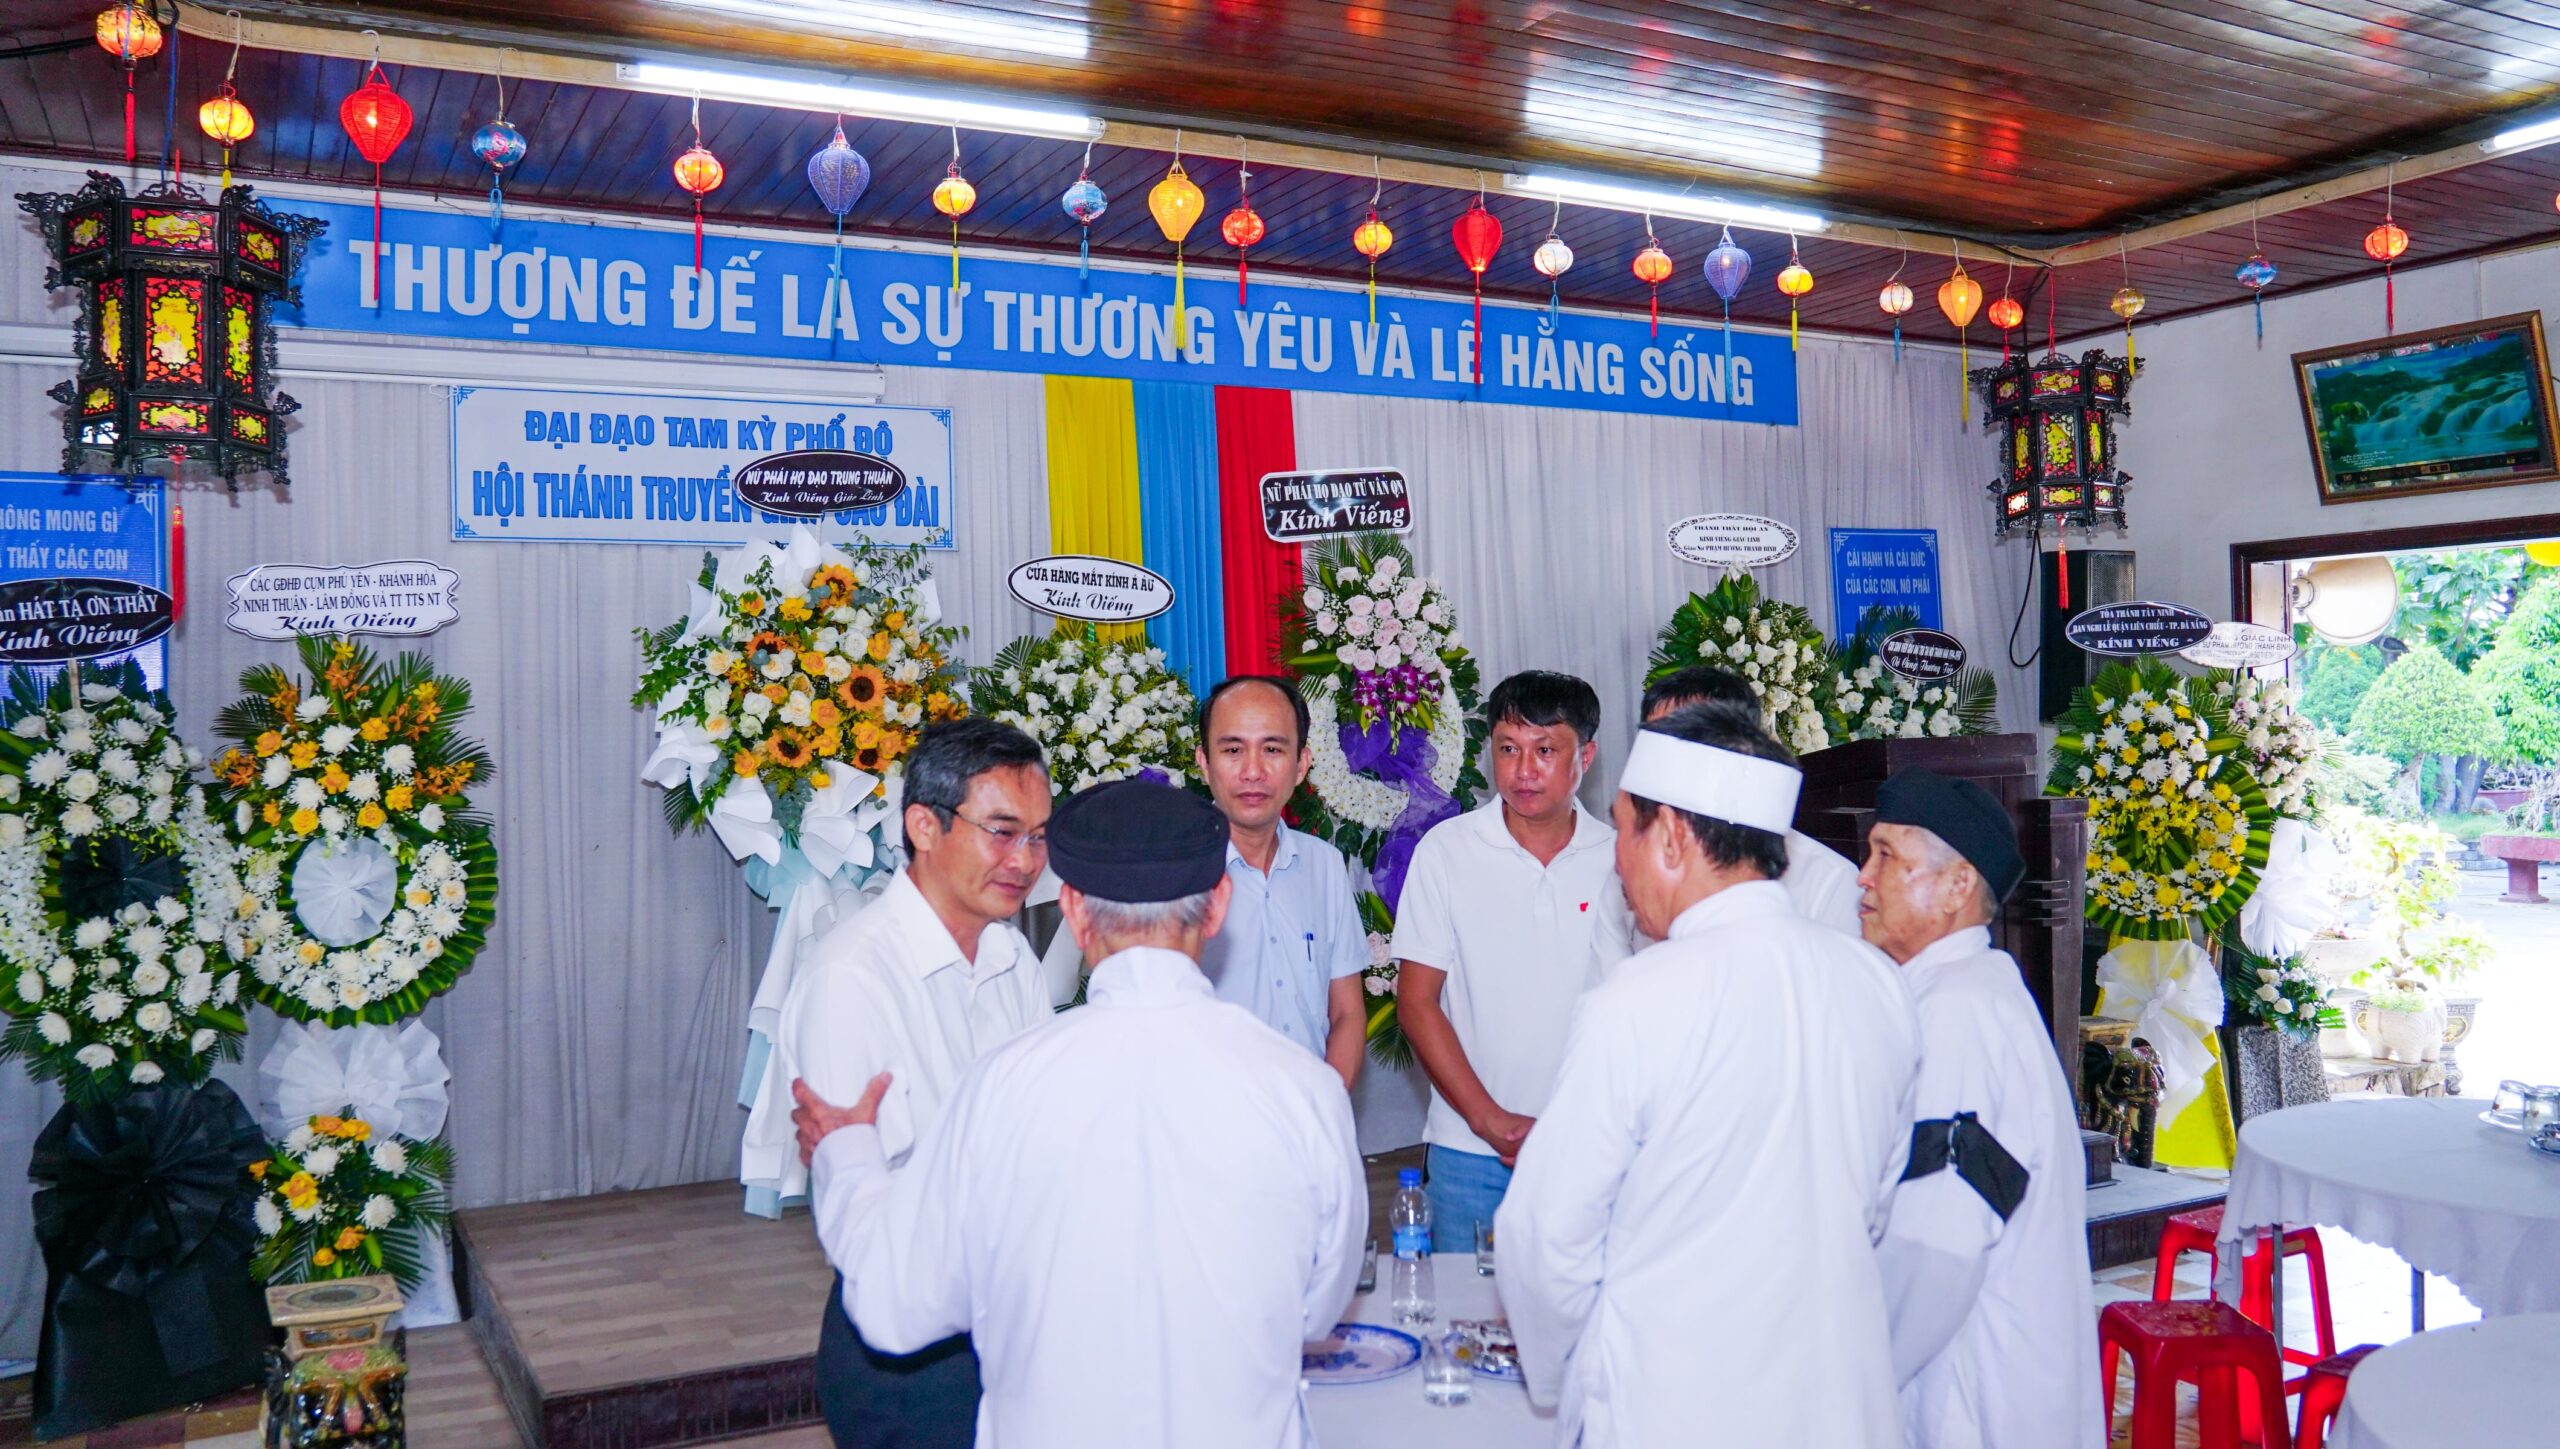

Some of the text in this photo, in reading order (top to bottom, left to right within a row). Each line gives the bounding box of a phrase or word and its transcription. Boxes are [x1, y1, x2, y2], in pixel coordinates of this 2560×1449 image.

[349, 240, 1754, 406] THƯỢNG ĐẾ LÀ SỰ THƯƠNG YÊU VÀ LẼ HẰNG SỐNG
[524, 410, 893, 461] ĐẠI ĐẠO TAM KỲ PHỔ ĐỘ
[745, 467, 893, 488] NỮ PHÁI HỌ ĐẠO TRUNG THUẬN
[1266, 481, 1282, 503] NỮ
[1284, 479, 1311, 501] PHÁI
[1314, 482, 1329, 503] HỌ
[1353, 477, 1367, 496] TỪ
[473, 462, 524, 527] HỘI
[533, 464, 632, 519] THÁNH
[641, 465, 752, 523] TRUYỀN
[894, 476, 938, 527] ĐÀI
[795, 490, 829, 504] Viếng
[0, 504, 118, 532] ÔNG MONG GÌ
[1279, 501, 1405, 531] Kính Viếng
[6, 540, 128, 570] THẤY CÁC CON
[1847, 548, 1926, 571] CÁI HẠNH VÀ CÁI ĐỨC
[250, 575, 270, 592] CÁC
[304, 576, 325, 592] CỤM
[328, 571, 348, 589] PHÚ
[350, 572, 371, 588] YÊN
[379, 570, 414, 587] KHÁNH
[416, 570, 437, 586] HÒA
[1026, 562, 1048, 581] CỬA
[1051, 566, 1079, 585] HÀNG
[1082, 567, 1103, 587] MẮT
[1105, 571, 1129, 589] KÍNH
[1131, 574, 1139, 590] Á
[1845, 573, 1931, 596] CỦA CÁC CON, NÓ PHẢI
[18, 595, 55, 620] HÁT
[58, 599, 84, 621] TẠ
[87, 595, 110, 615] ƠN
[113, 586, 158, 613] THẦY
[244, 598, 269, 613] NINH
[272, 594, 307, 614] THUẬN
[316, 593, 337, 610] LÂM
[341, 588, 370, 608] ĐỒNG
[373, 590, 387, 607] VÀ
[390, 593, 402, 607] TT
[406, 592, 424, 606] TTS
[427, 592, 440, 606] NT
[1040, 588, 1133, 616] Kính Viếng
[2116, 608, 2140, 618] THÁNH
[2141, 607, 2156, 617] TÂY
[2157, 608, 2175, 617] NINH
[58, 623, 142, 646] Viếng
[272, 612, 417, 631] Kính Viếng
[2112, 621, 2129, 633] QUẬN
[2130, 621, 2144, 631] LIÊN
[2097, 637, 2133, 649] KÍNH
[2137, 634, 2180, 648] VIẾNG
